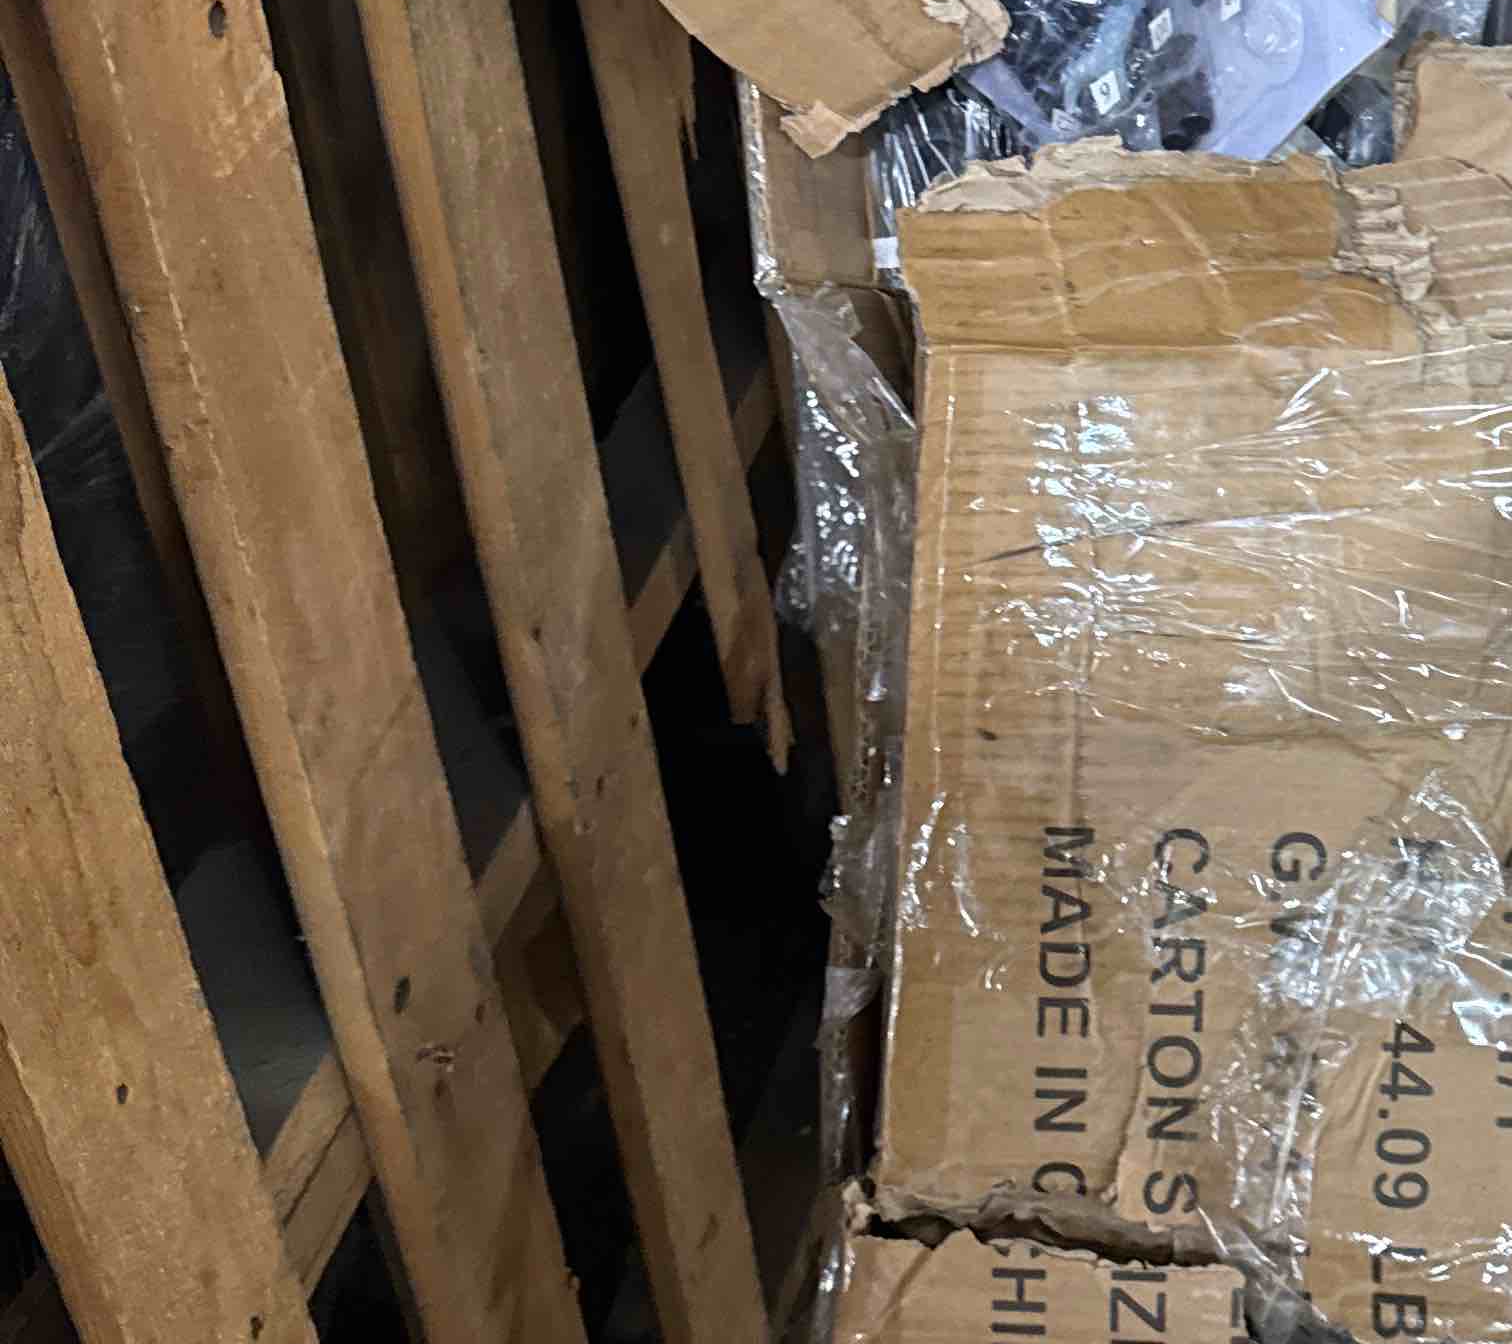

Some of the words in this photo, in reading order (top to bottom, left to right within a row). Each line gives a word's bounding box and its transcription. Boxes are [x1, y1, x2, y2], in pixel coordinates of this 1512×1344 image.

[1032, 824, 1091, 1038] MADE
[1143, 828, 1209, 1145] CARTON
[1029, 1067, 1086, 1143] IN
[1373, 1022, 1435, 1210] 44.09
